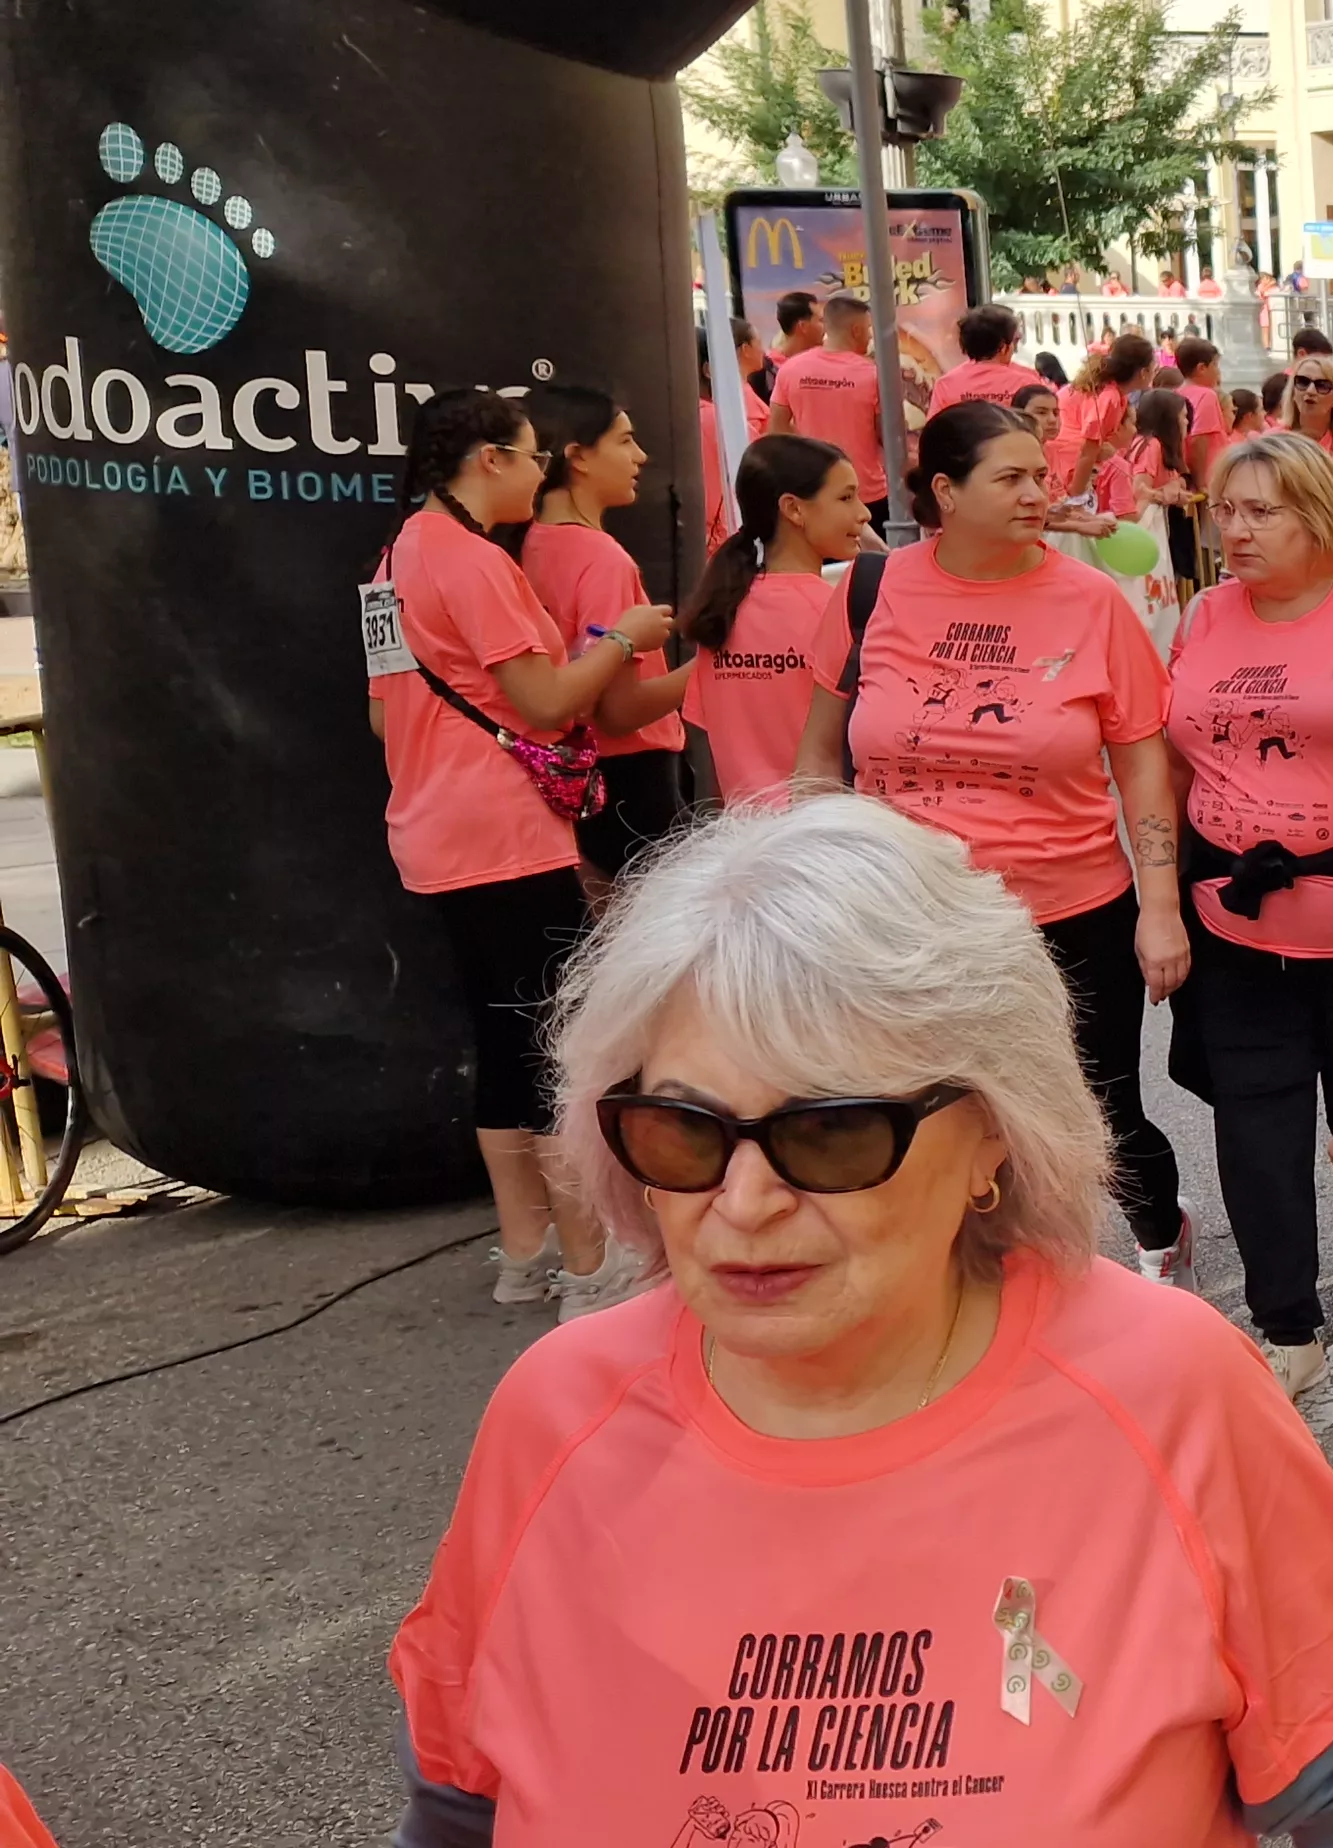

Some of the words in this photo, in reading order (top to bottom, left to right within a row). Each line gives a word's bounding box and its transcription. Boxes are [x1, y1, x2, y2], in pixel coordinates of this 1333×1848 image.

[27, 454, 190, 497] PODOLOGÍA
[209, 467, 229, 498] Y
[247, 469, 428, 504] BIOME
[945, 621, 1012, 645] CORRAMOS
[928, 641, 955, 659] POR
[954, 642, 970, 662] LA
[970, 642, 1018, 665] CIENCIA
[727, 1628, 933, 1701] CORRAMOS
[678, 1705, 755, 1775] POR
[756, 1704, 801, 1773] LA
[807, 1699, 956, 1773] CIENCIA
[806, 1780, 819, 1801] XI
[819, 1783, 866, 1801] Carrera
[867, 1778, 908, 1800] Huesca
[910, 1781, 950, 1799] contra
[951, 1776, 964, 1797] el
